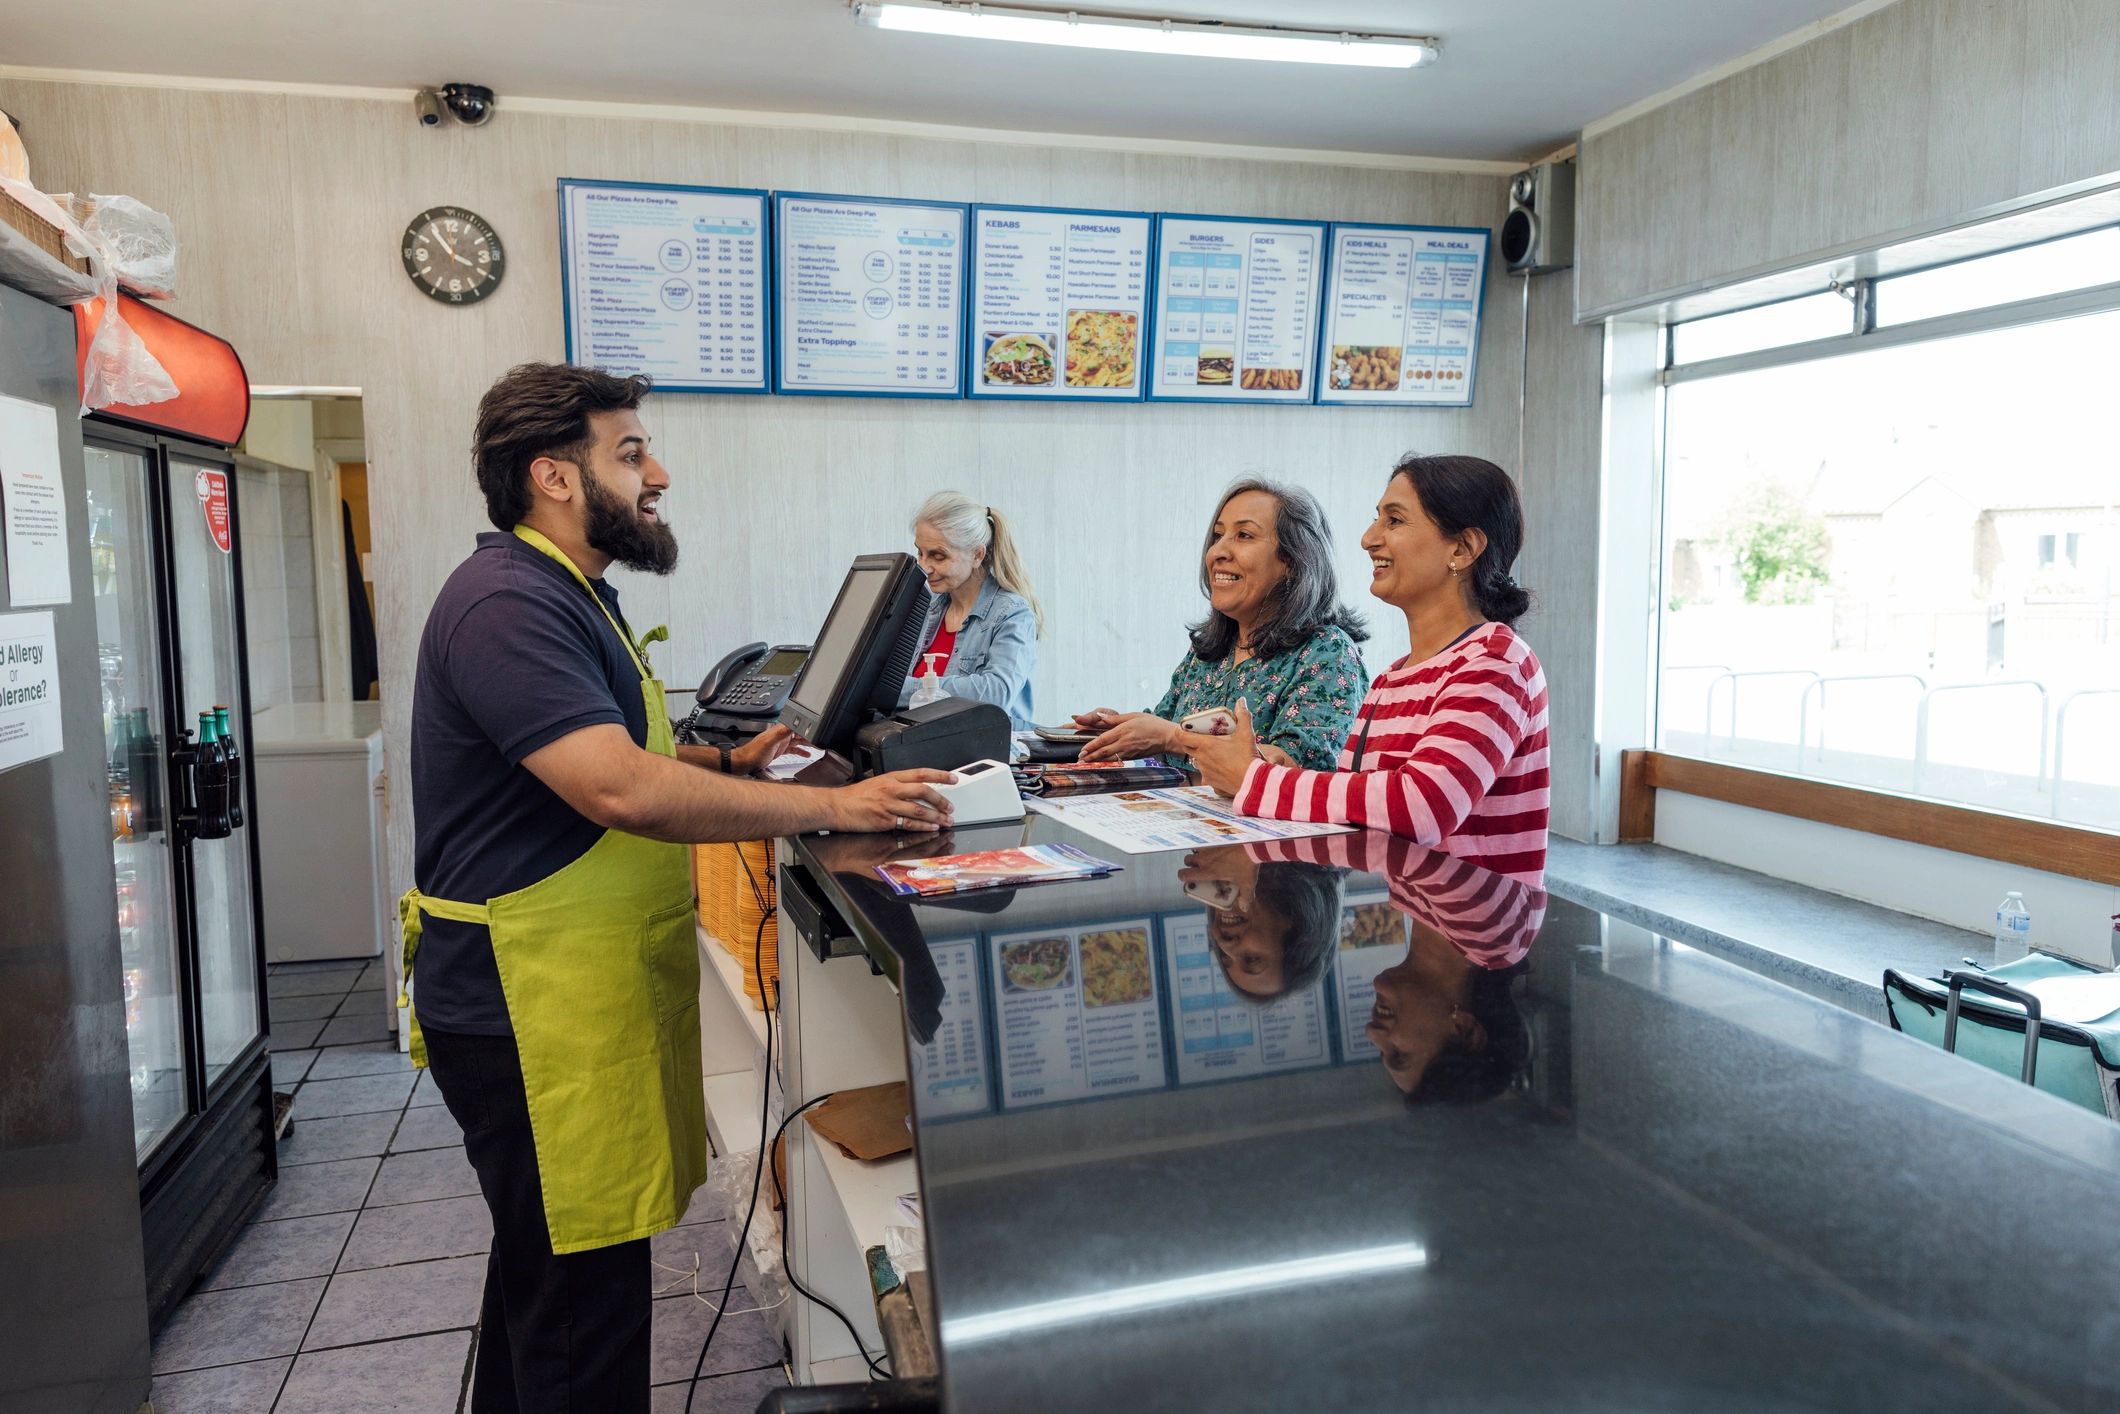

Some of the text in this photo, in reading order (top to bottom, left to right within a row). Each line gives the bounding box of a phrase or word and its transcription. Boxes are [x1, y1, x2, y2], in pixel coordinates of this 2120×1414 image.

[444, 220, 458, 232] 12
[986, 220, 1020, 228] KEBABS
[1070, 225, 1121, 233] PARMESANS
[1190, 234, 1224, 242] BURGERS
[415, 248, 429, 261] 9
[478, 250, 490, 263] 3
[449, 279, 462, 292] 6
[451, 293, 462, 301] 30
[822, 338, 856, 346] Toppings
[8, 644, 43, 664] Allergy
[10, 670, 18, 682] or
